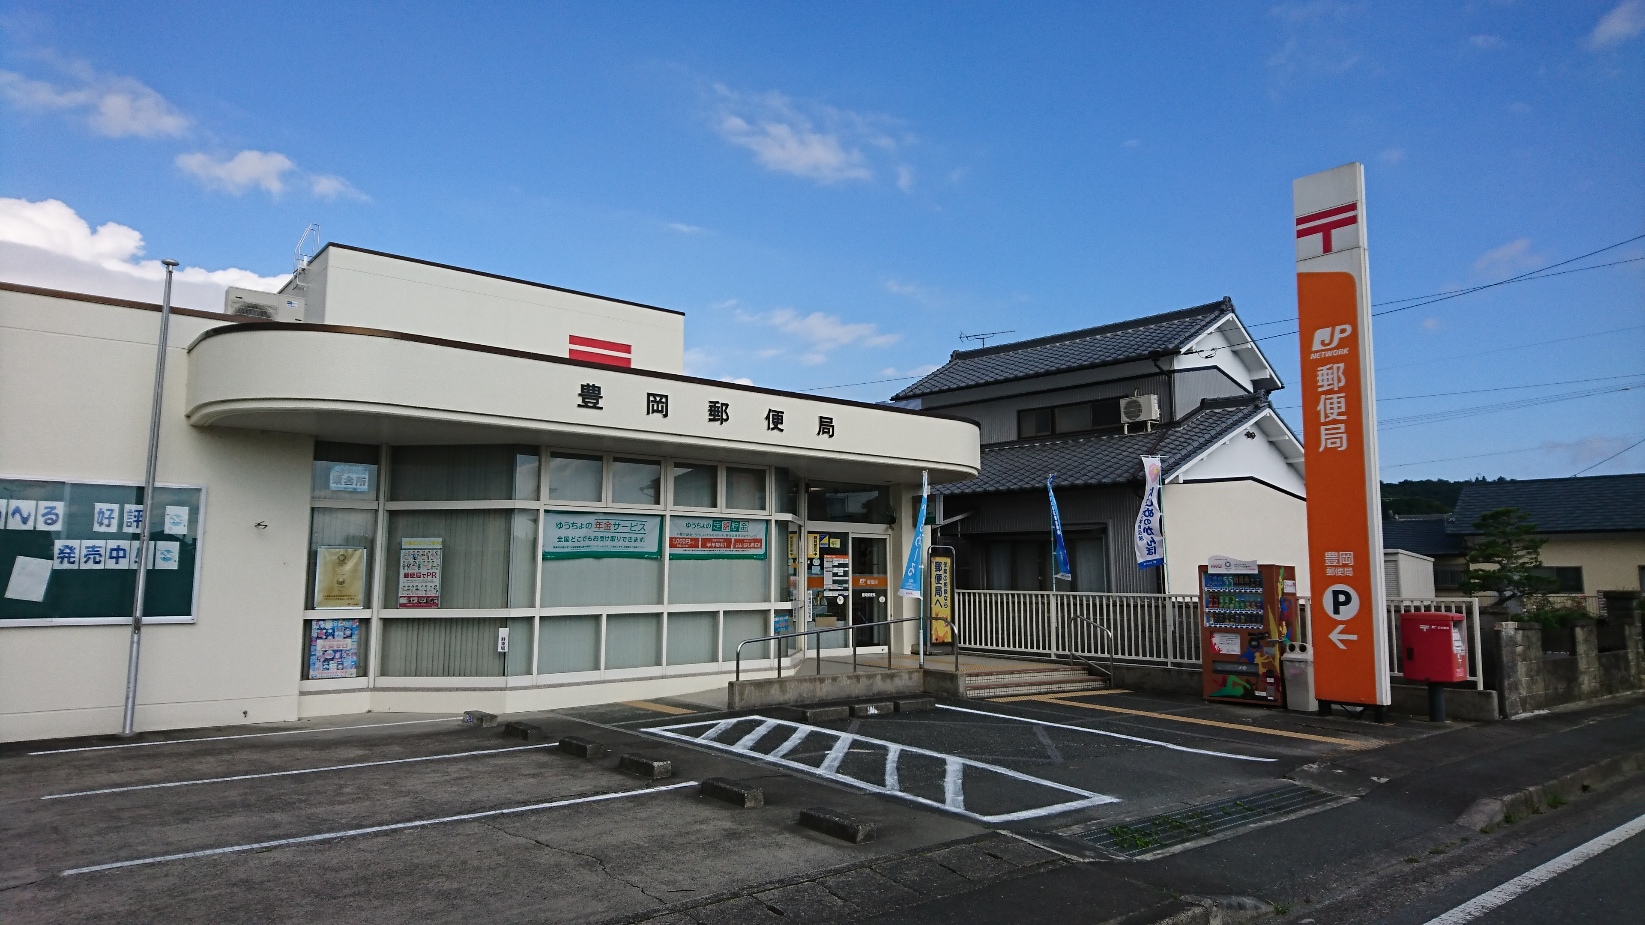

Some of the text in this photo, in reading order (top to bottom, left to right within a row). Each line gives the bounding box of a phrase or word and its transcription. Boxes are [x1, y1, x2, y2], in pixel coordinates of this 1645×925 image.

[1311, 324, 1352, 351] JP
[1310, 348, 1349, 360] NETWORK
[577, 383, 835, 438] 豊岡郵便局
[1316, 362, 1348, 452] 郵便局
[0, 505, 60, 526] 〜る
[97, 508, 143, 528] 好評
[556, 521, 646, 532] ゆうちょの年金サービス
[1325, 551, 1354, 566] 豊岡
[1326, 567, 1353, 577] 郵便局
[934, 561, 943, 609] 郵便局へ
[1332, 590, 1352, 615] P
